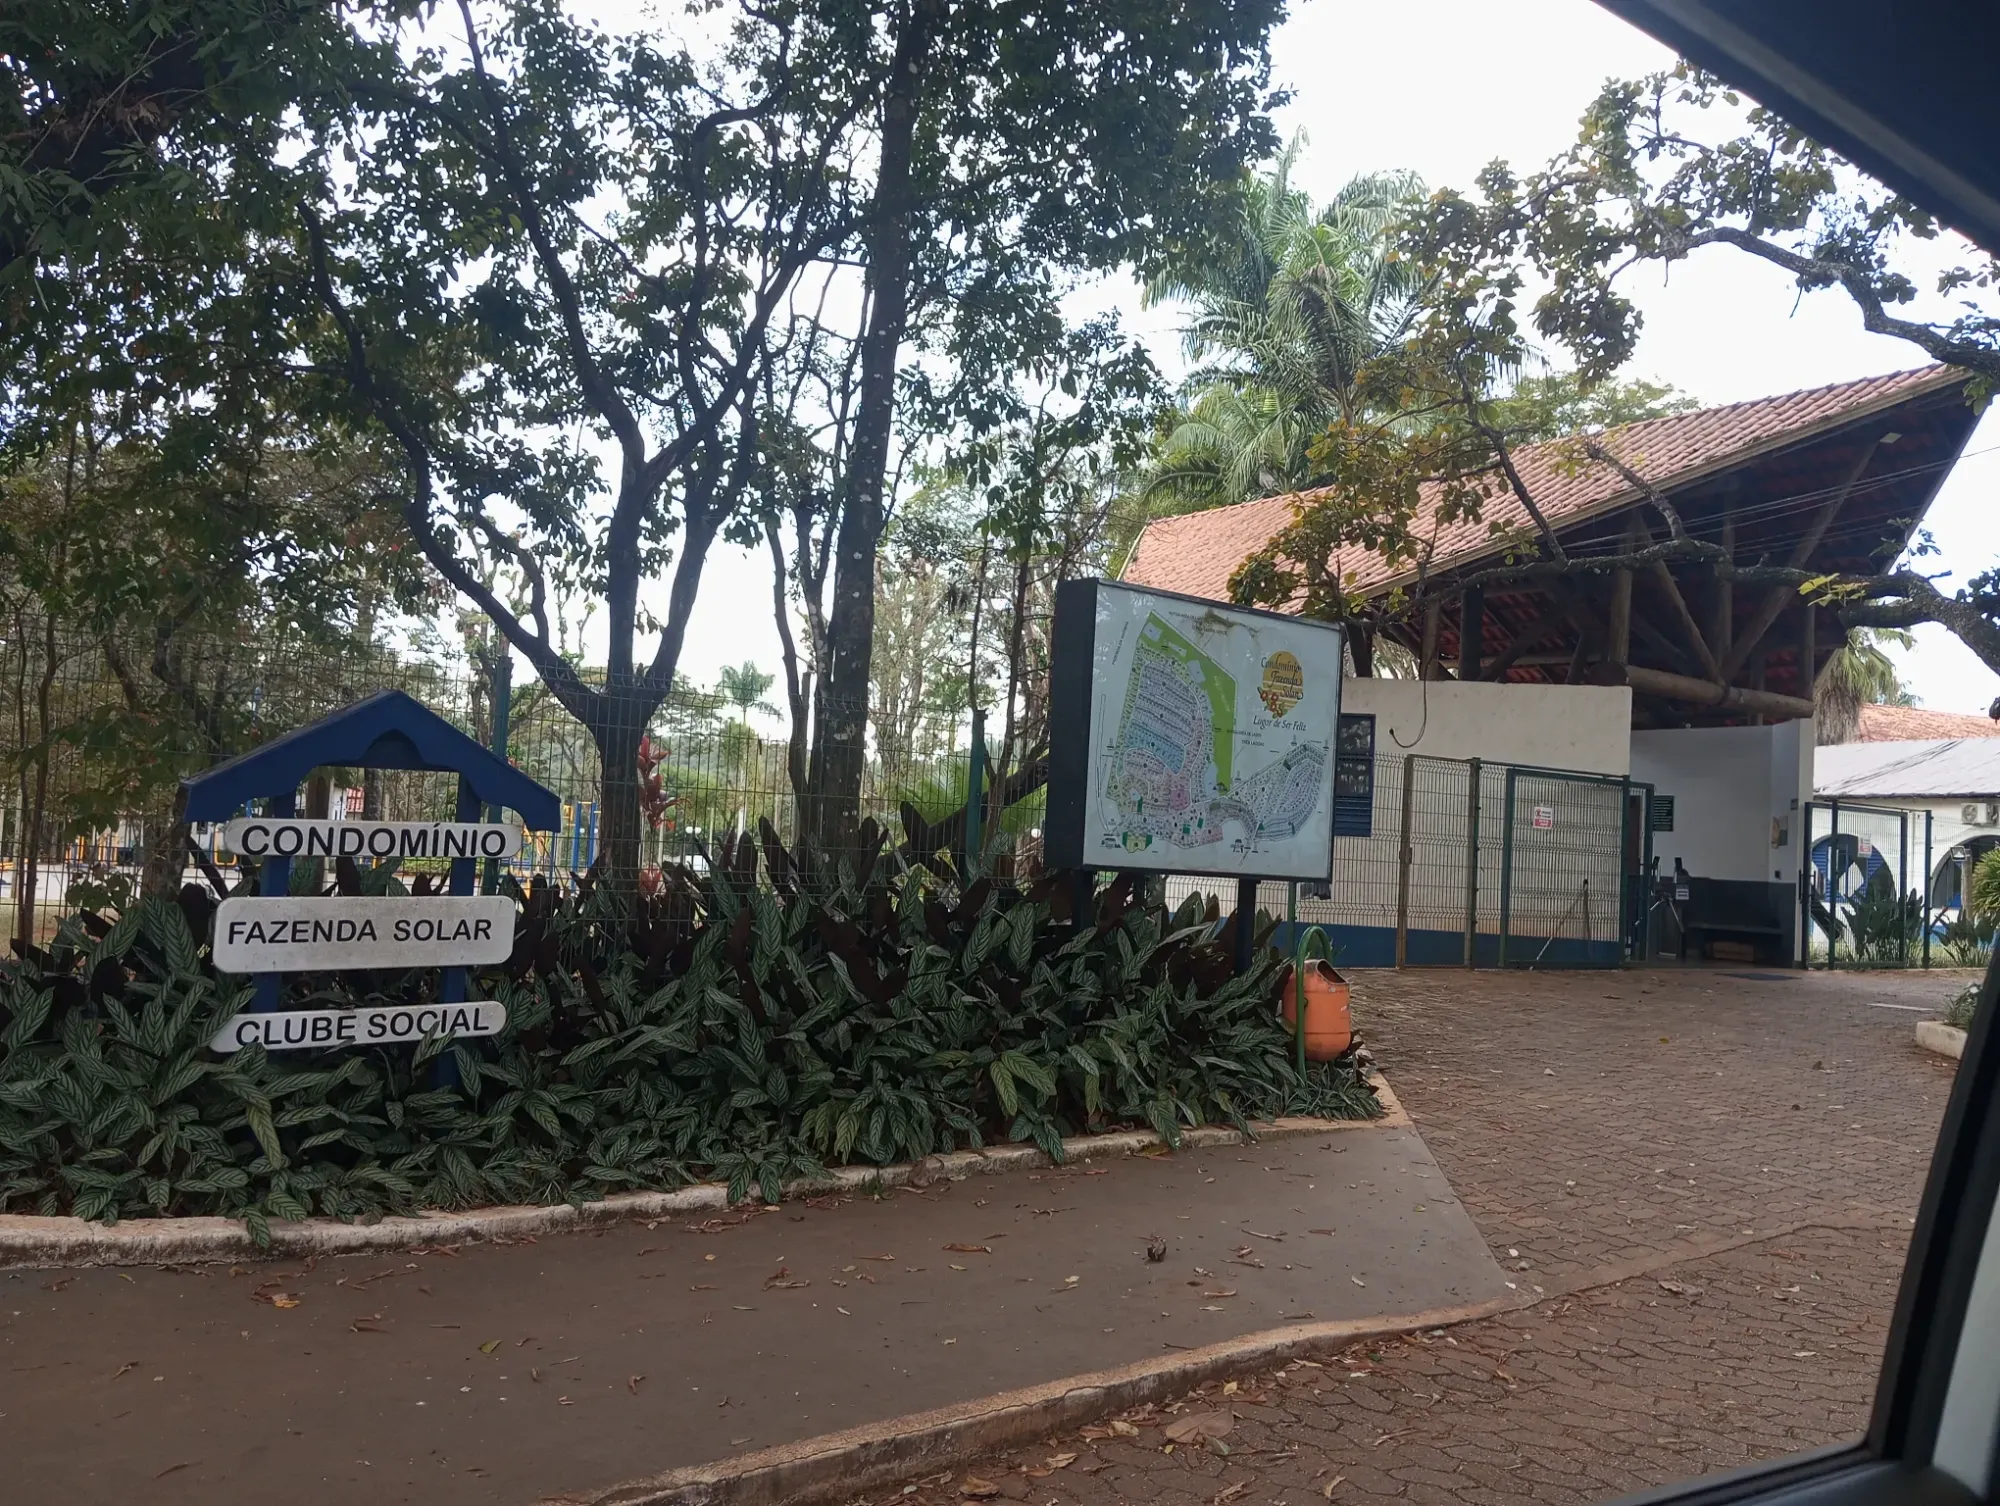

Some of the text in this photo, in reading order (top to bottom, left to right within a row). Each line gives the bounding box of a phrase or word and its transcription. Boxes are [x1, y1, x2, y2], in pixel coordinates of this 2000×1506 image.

[1281, 719, 1292, 729] Ser
[1292, 720, 1307, 731] Feliz
[241, 823, 506, 858] CONDOMÍNIO
[228, 919, 492, 945] FAZENDA SOLAR
[235, 1008, 489, 1046] CLUBE SOCIAL
